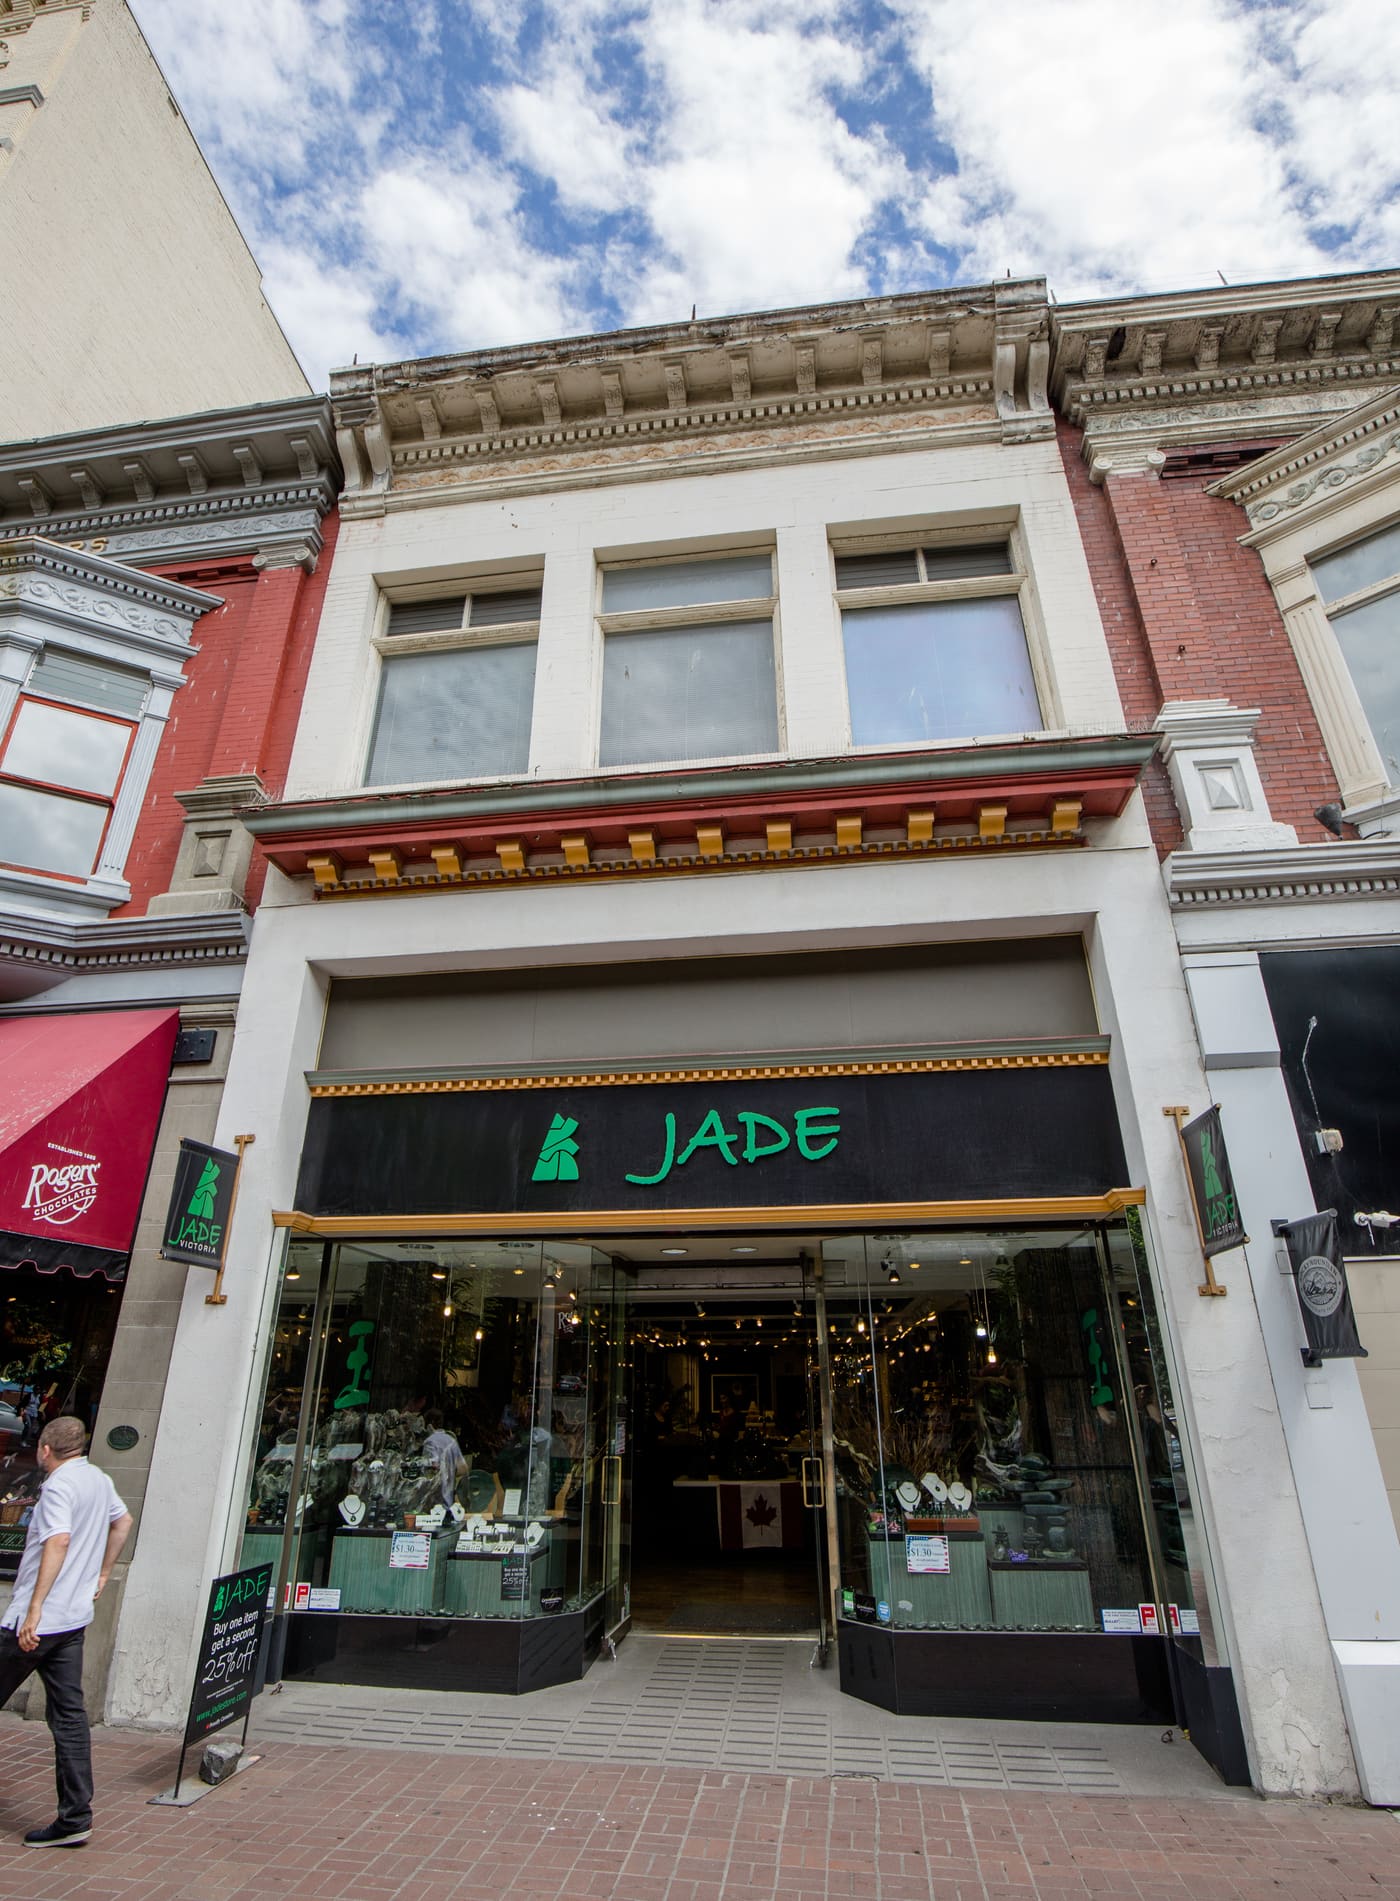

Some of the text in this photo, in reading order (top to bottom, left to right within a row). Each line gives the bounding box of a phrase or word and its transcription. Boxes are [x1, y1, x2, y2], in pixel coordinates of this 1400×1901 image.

[624, 1108, 841, 1185] JADE
[33, 1187, 97, 1217] CHOCOLATES
[168, 1216, 222, 1246] JADE
[180, 1239, 217, 1255] VICTORIA
[211, 1571, 268, 1621] JADE
[213, 1610, 259, 1636] Buy one item
[211, 1623, 256, 1655] get a second
